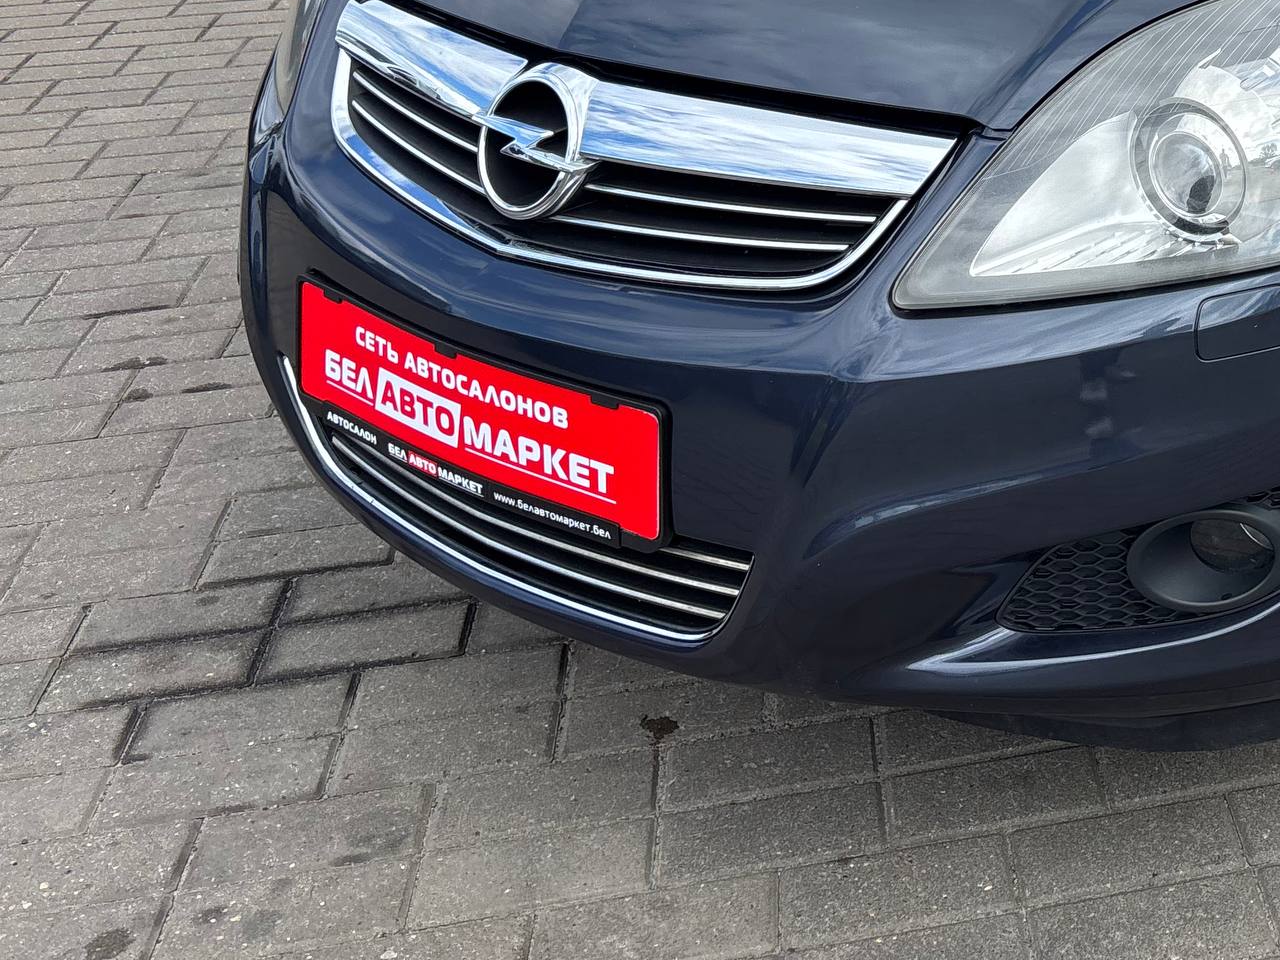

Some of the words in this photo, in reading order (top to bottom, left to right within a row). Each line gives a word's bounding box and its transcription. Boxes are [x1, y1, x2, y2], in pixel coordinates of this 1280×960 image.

[355, 326, 399, 364] СЕТЬ
[403, 351, 569, 429] АВТОСАЛОНОВ
[326, 411, 378, 445] АВТОСАЛОН
[493, 491, 612, 540] www.белавтомаркет.бел
